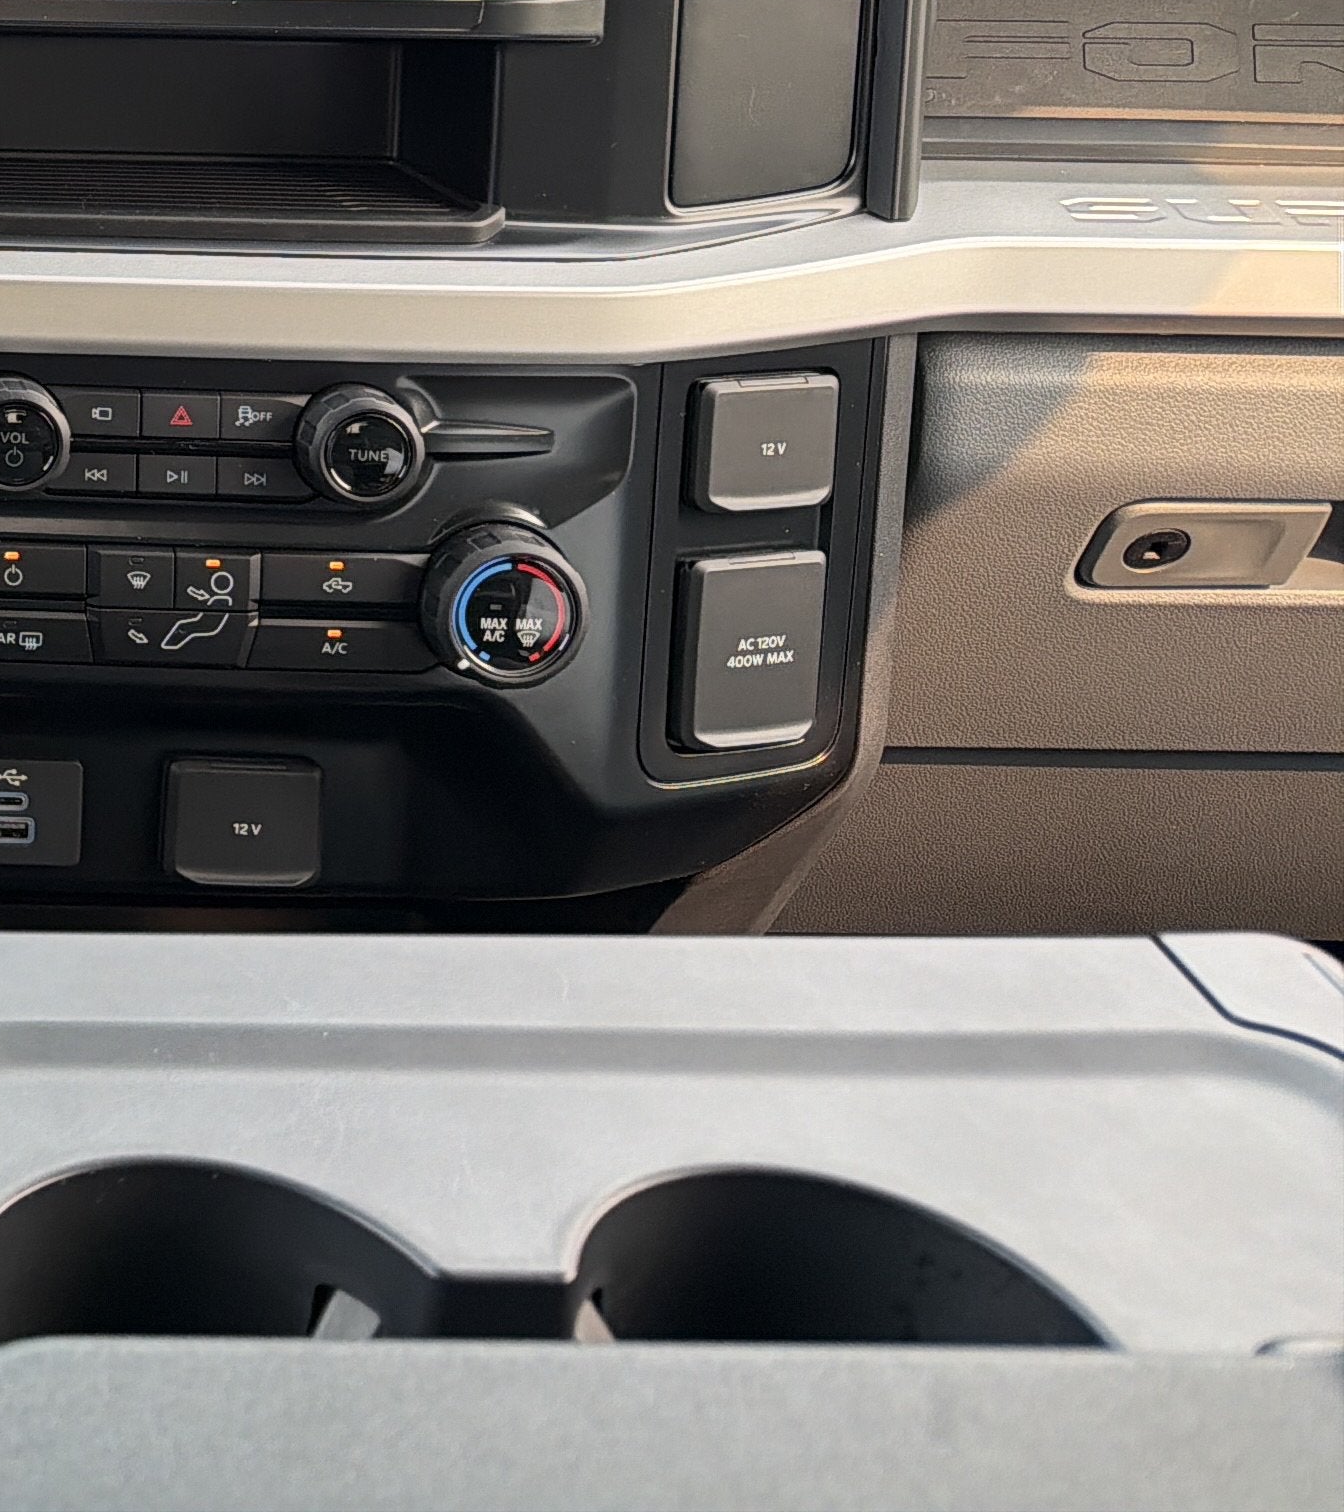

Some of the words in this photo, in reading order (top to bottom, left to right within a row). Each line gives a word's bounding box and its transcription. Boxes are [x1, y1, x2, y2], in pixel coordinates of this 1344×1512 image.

[252, 410, 273, 423] OFF
[0, 431, 31, 446] VOL
[347, 449, 388, 462] TUNE
[761, 442, 775, 455] 12
[776, 442, 786, 455] V
[479, 617, 507, 632] MAX
[515, 618, 543, 632] MAX
[482, 629, 506, 644] A/C
[737, 638, 755, 651] AC
[756, 635, 786, 650] 120V
[321, 641, 348, 656] A/C
[726, 653, 764, 669] 400W
[766, 650, 794, 665] MAX
[232, 822, 248, 836] 12
[249, 823, 262, 837] V
